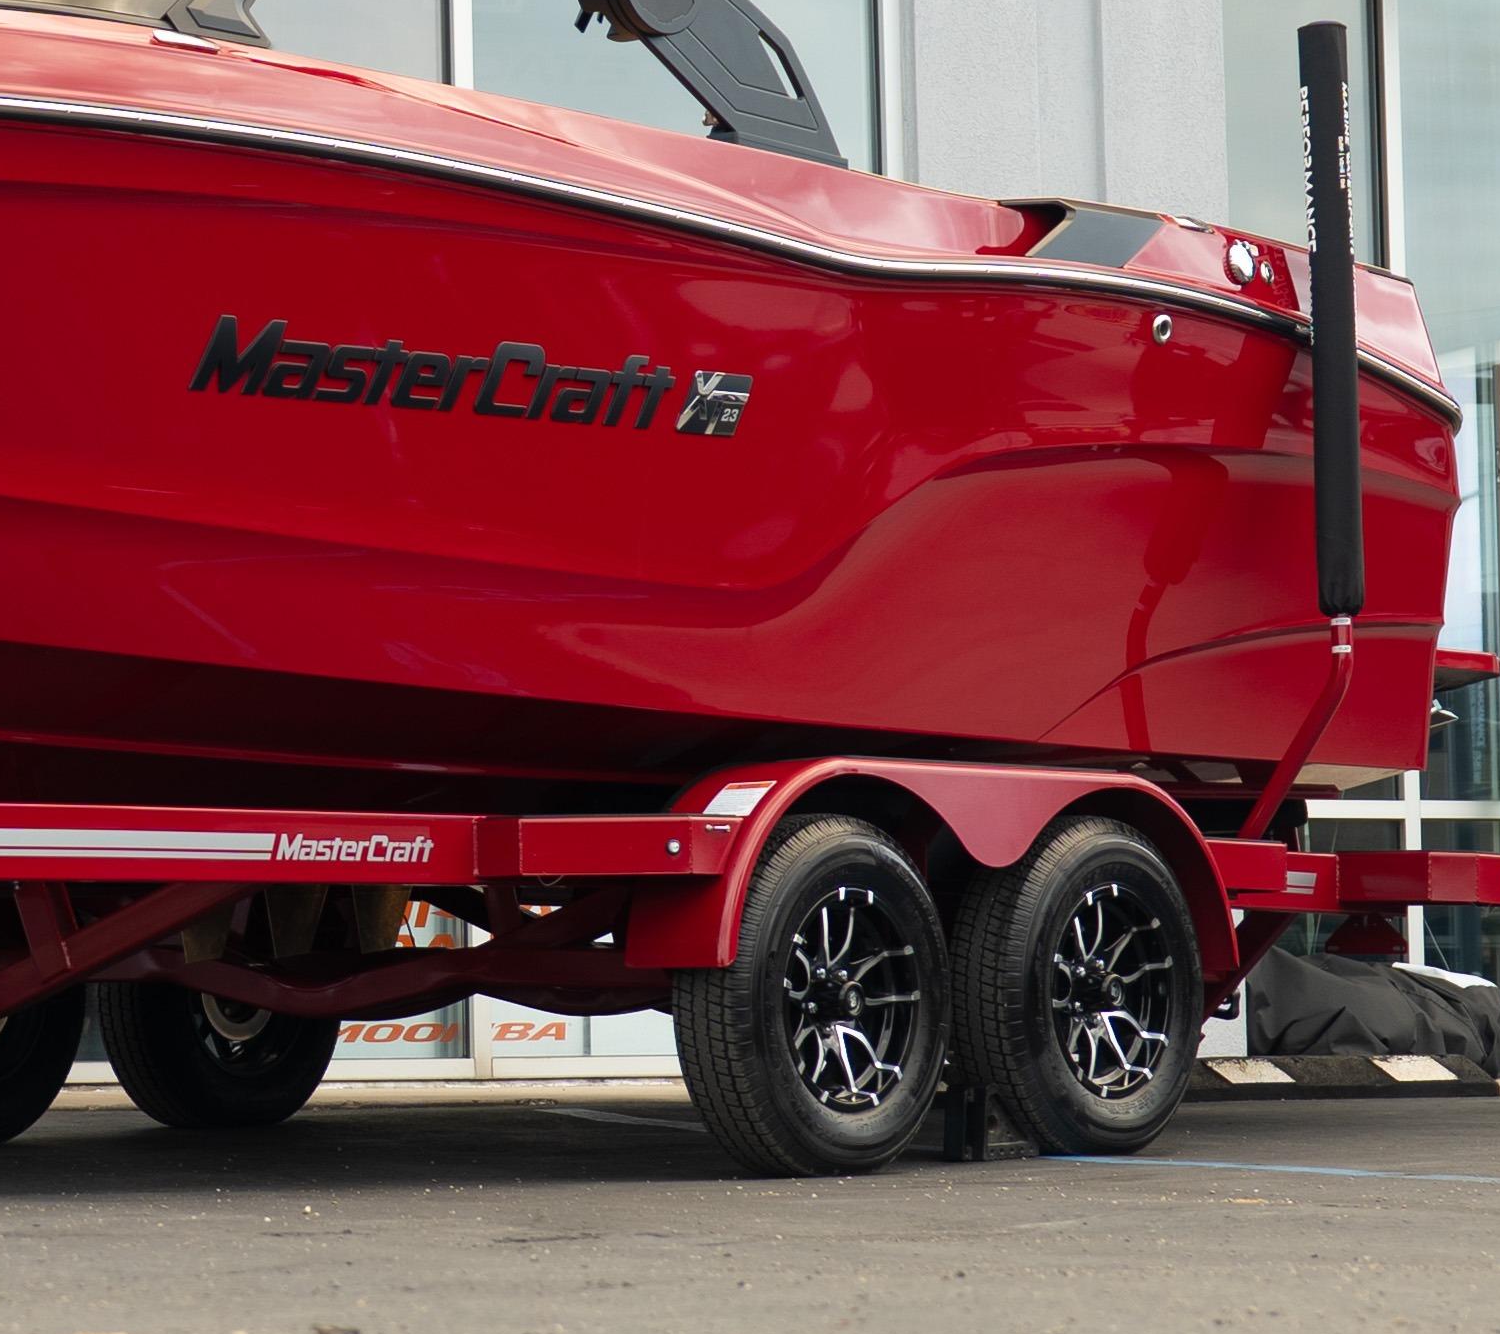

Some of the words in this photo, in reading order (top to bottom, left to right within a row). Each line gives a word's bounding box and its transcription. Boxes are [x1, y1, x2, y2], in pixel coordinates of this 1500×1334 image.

[188, 314, 675, 430] MasterCraft
[721, 407, 739, 424] 23
[275, 833, 434, 864] MasterCraft
